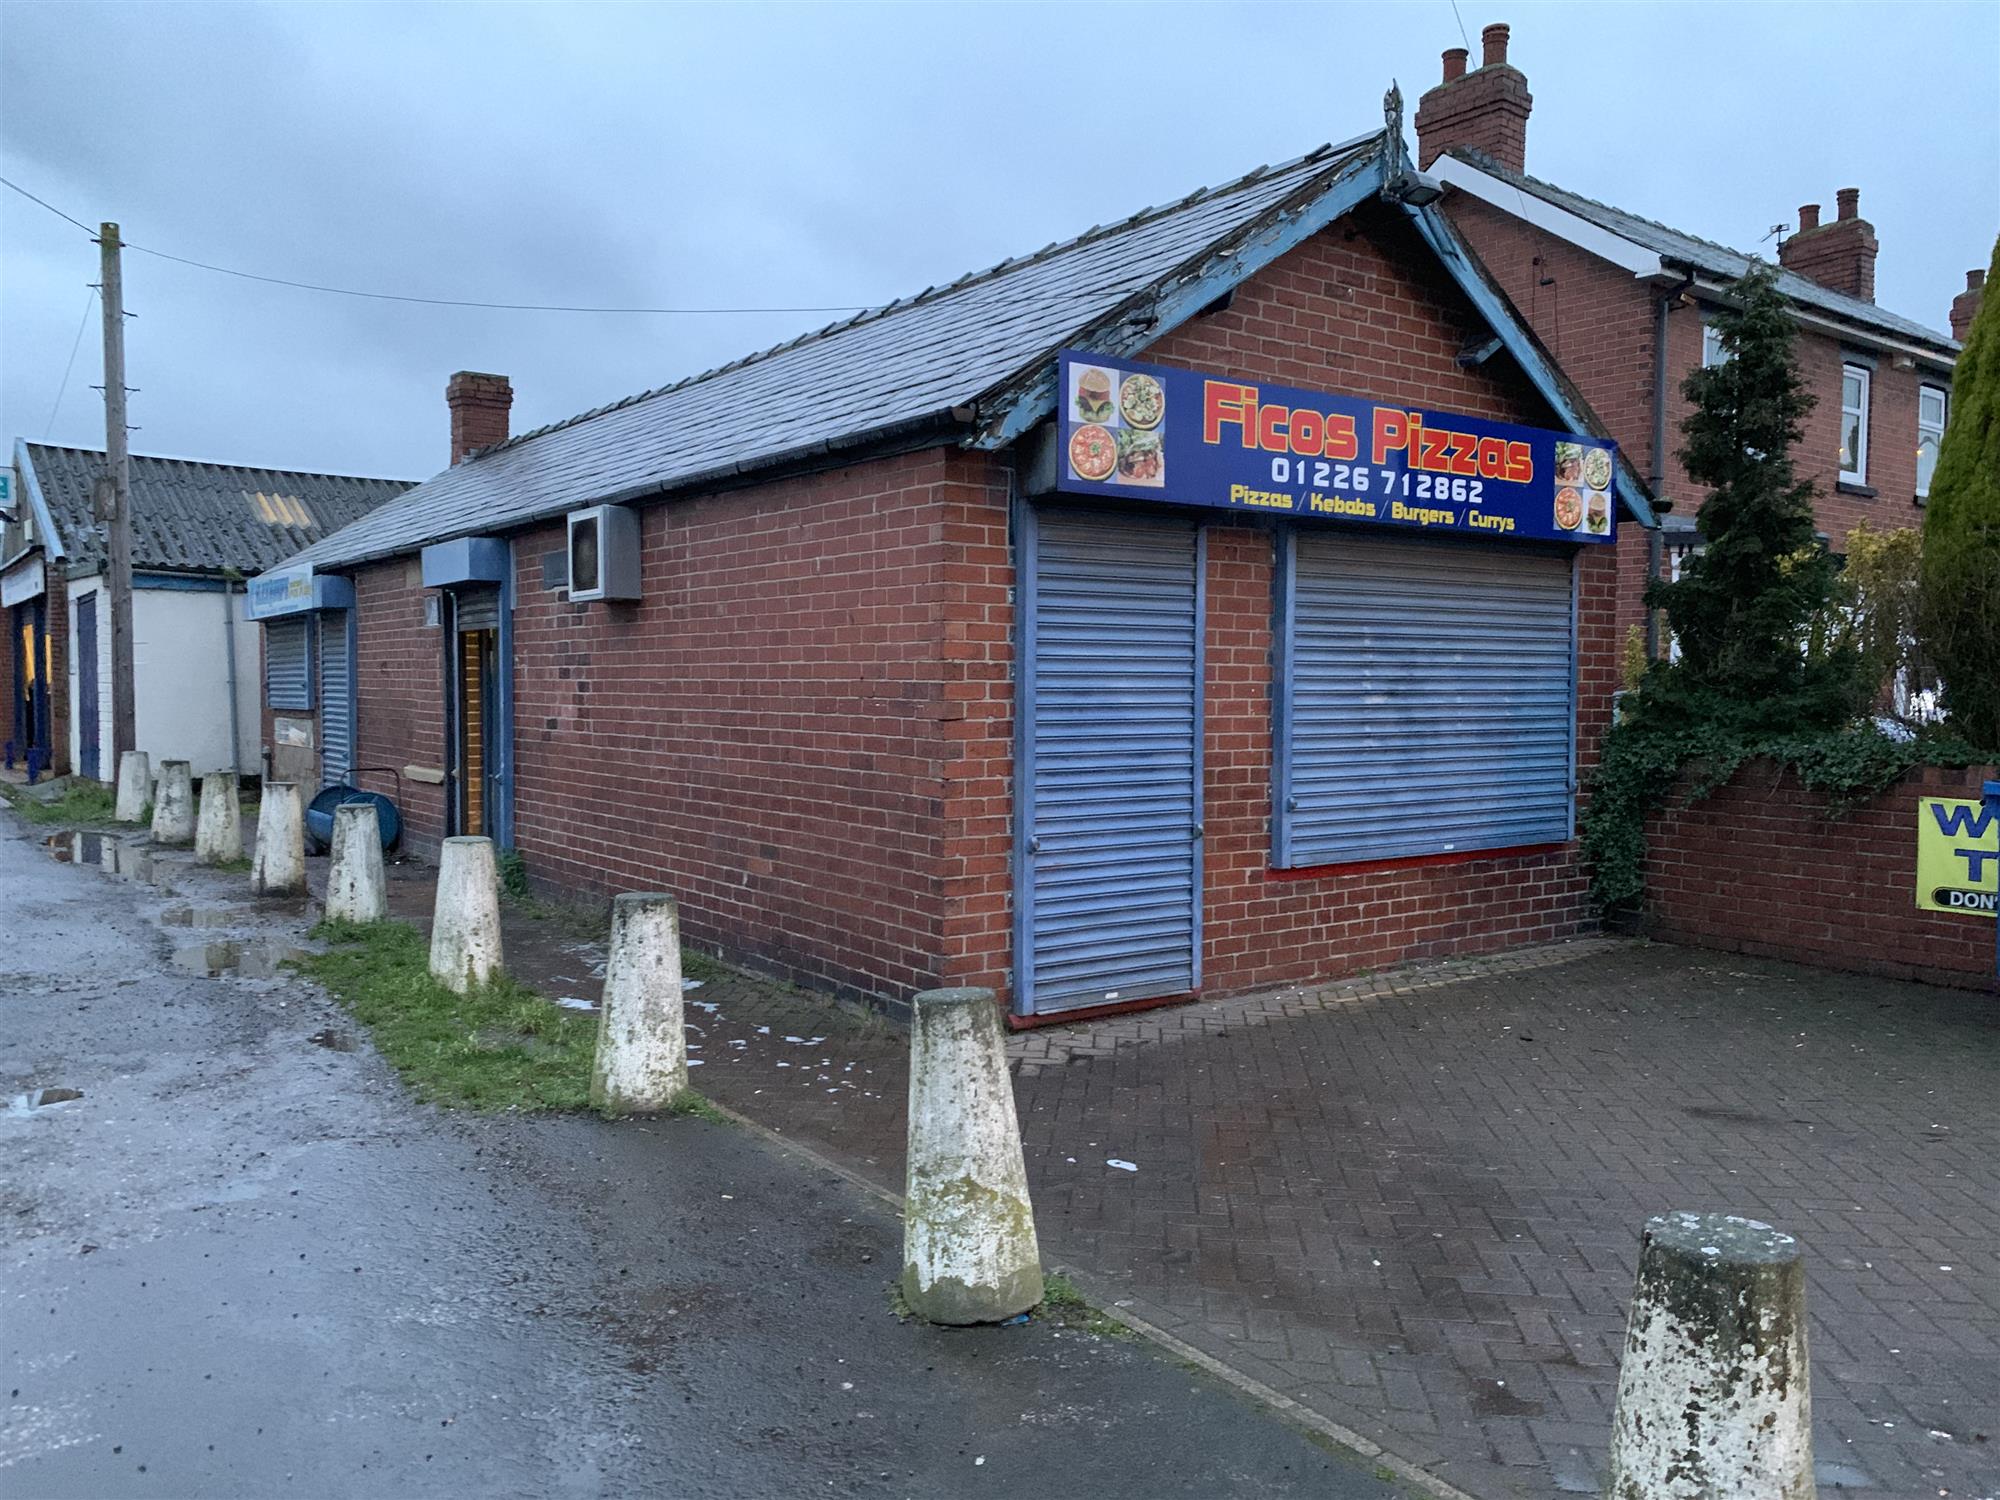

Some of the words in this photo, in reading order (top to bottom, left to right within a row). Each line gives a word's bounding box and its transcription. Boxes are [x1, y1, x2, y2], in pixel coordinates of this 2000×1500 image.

[1203, 379, 1358, 461] Ficos
[1372, 406, 1534, 484] Pizzas
[1271, 457, 1369, 491] 01226
[1381, 470, 1484, 504] 712862
[1230, 484, 1293, 509] Pizzas
[1310, 492, 1376, 517] Kebabs
[1391, 501, 1455, 526] Burgers
[1468, 509, 1516, 533] Currys
